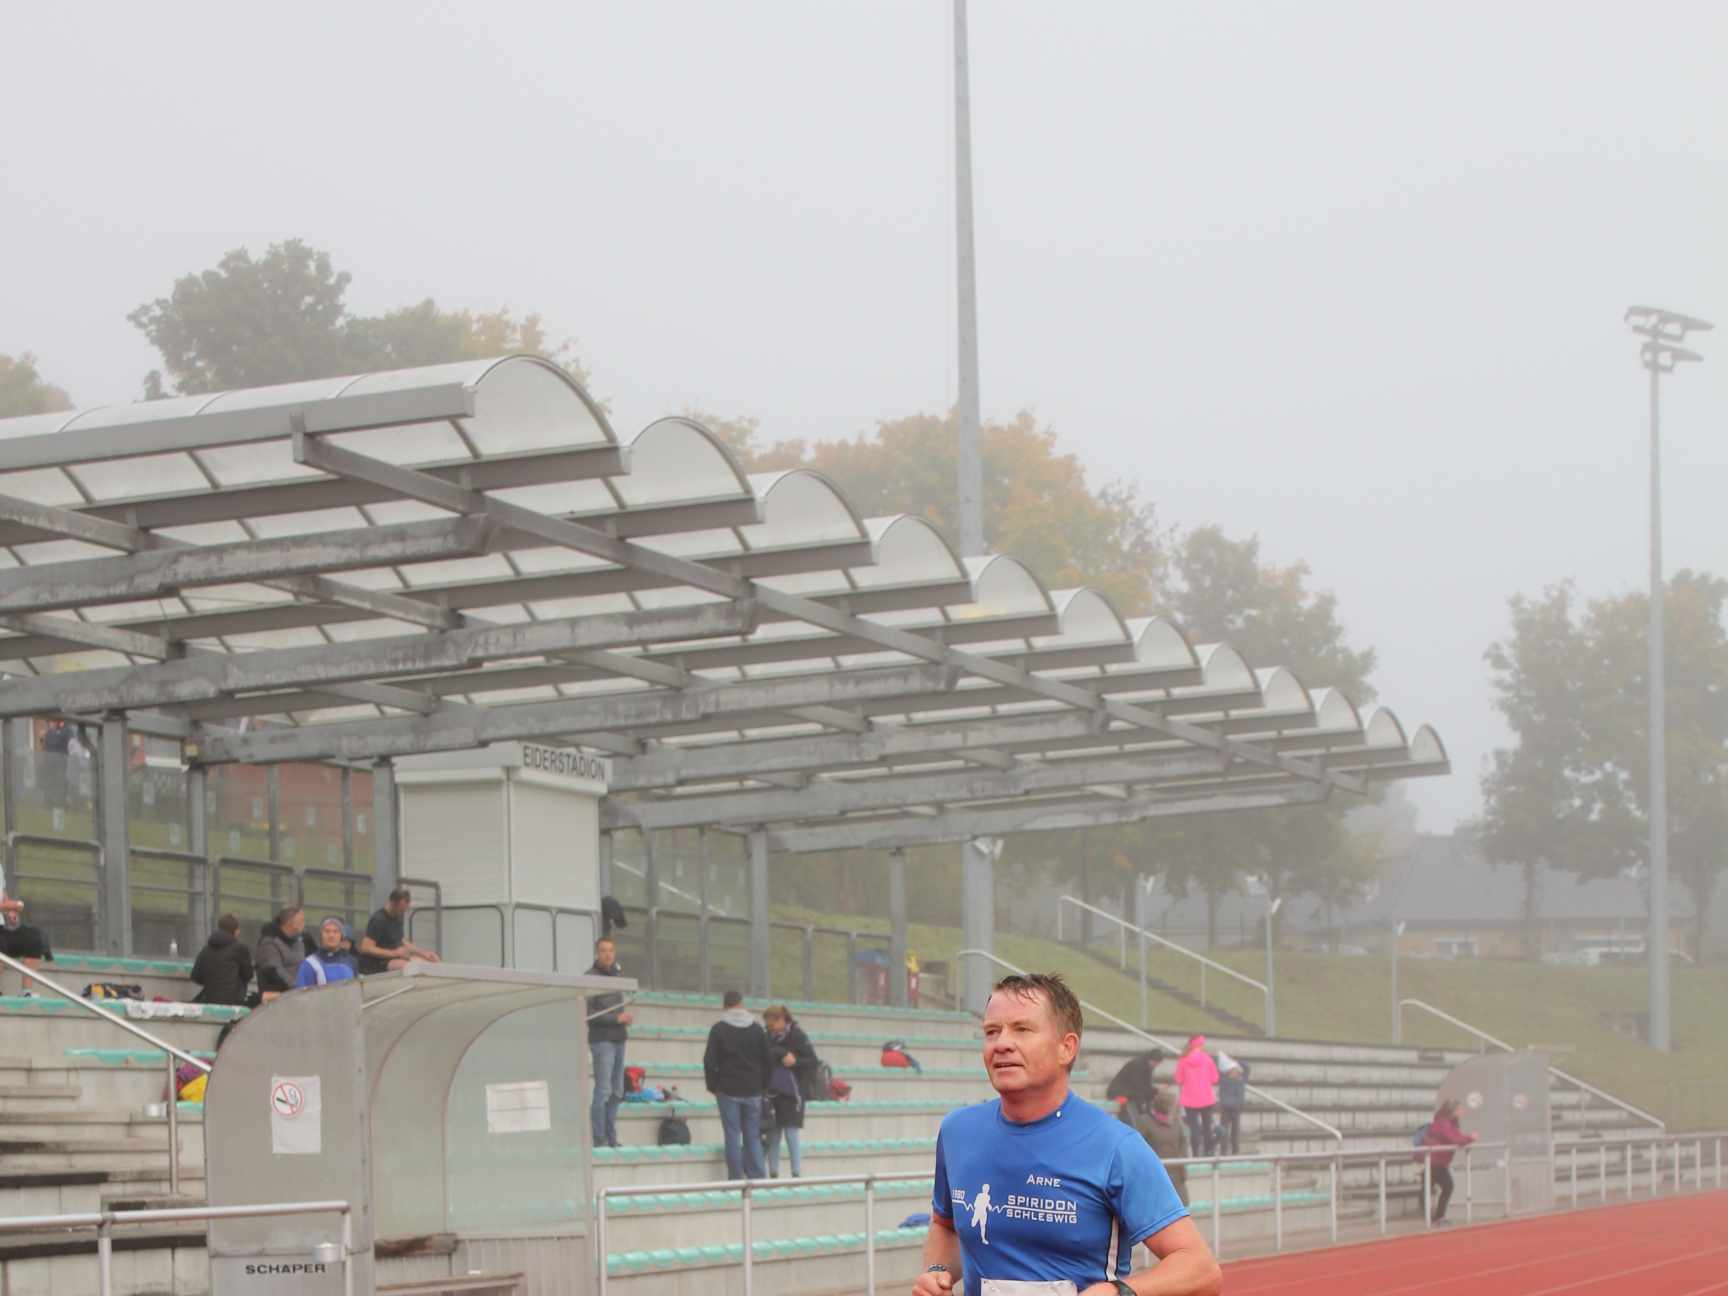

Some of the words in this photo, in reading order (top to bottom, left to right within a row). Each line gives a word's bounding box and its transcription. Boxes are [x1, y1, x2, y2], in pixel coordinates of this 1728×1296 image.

[522, 744, 606, 780] EIDERSTADION
[1007, 1195, 1077, 1211] SPIRIDON
[1006, 1209, 1078, 1224] SCHLESWIG
